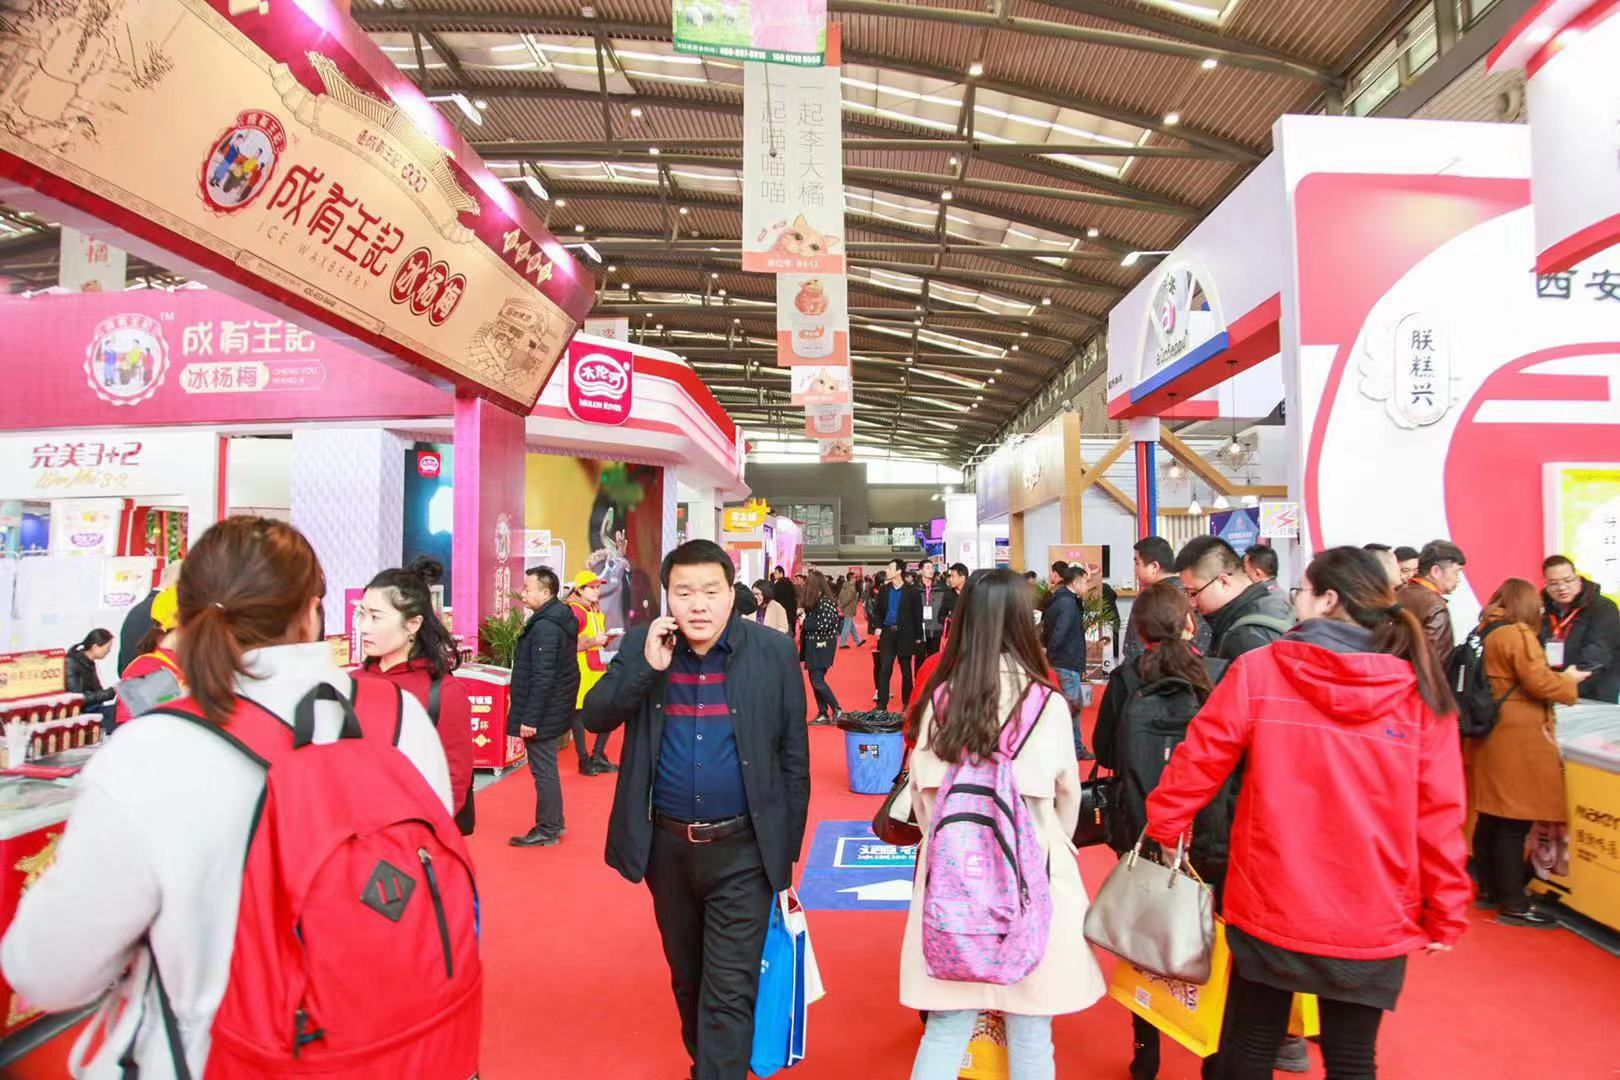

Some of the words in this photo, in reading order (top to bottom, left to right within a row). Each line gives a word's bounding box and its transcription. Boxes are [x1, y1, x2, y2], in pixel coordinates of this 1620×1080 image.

[798, 85, 826, 207] 一起李大橘
[256, 221, 289, 245] ICE
[393, 252, 465, 322] 冰杨梅
[187, 366, 259, 390] 冰杨梅
[28, 442, 143, 469] 完美3+2
